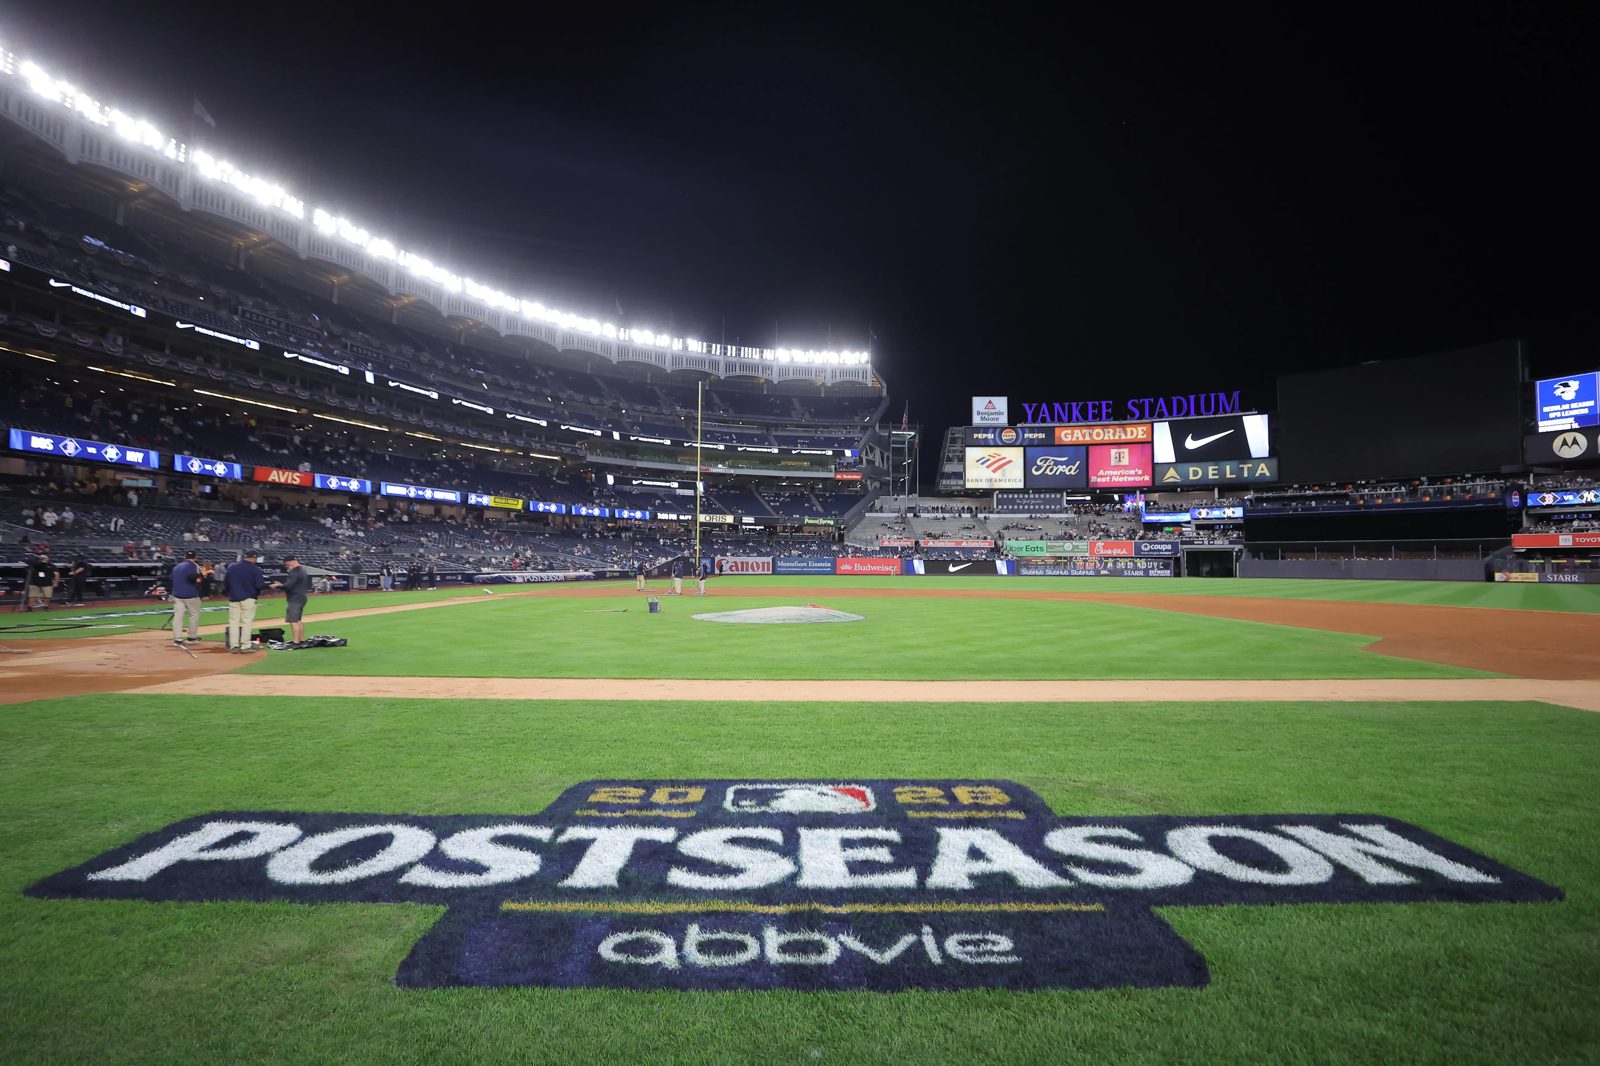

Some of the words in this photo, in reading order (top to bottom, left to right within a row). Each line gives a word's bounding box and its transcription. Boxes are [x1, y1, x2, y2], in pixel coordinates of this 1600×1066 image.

[1022, 400, 1113, 424] YANKEE
[1127, 391, 1242, 420] STADIUM
[1060, 426, 1147, 442] GATORADE
[1031, 456, 1080, 475] Ford
[1098, 468, 1143, 476] America's
[1188, 463, 1271, 480] DELTA
[268, 470, 301, 484] AVIS
[715, 558, 771, 573] Canon
[854, 563, 897, 571] Budweiser
[523, 573, 565, 582] POSTSEASON
[1547, 574, 1579, 582] STARR
[88, 820, 1502, 889] POSTSEASON
[598, 923, 1023, 970] abbvie
